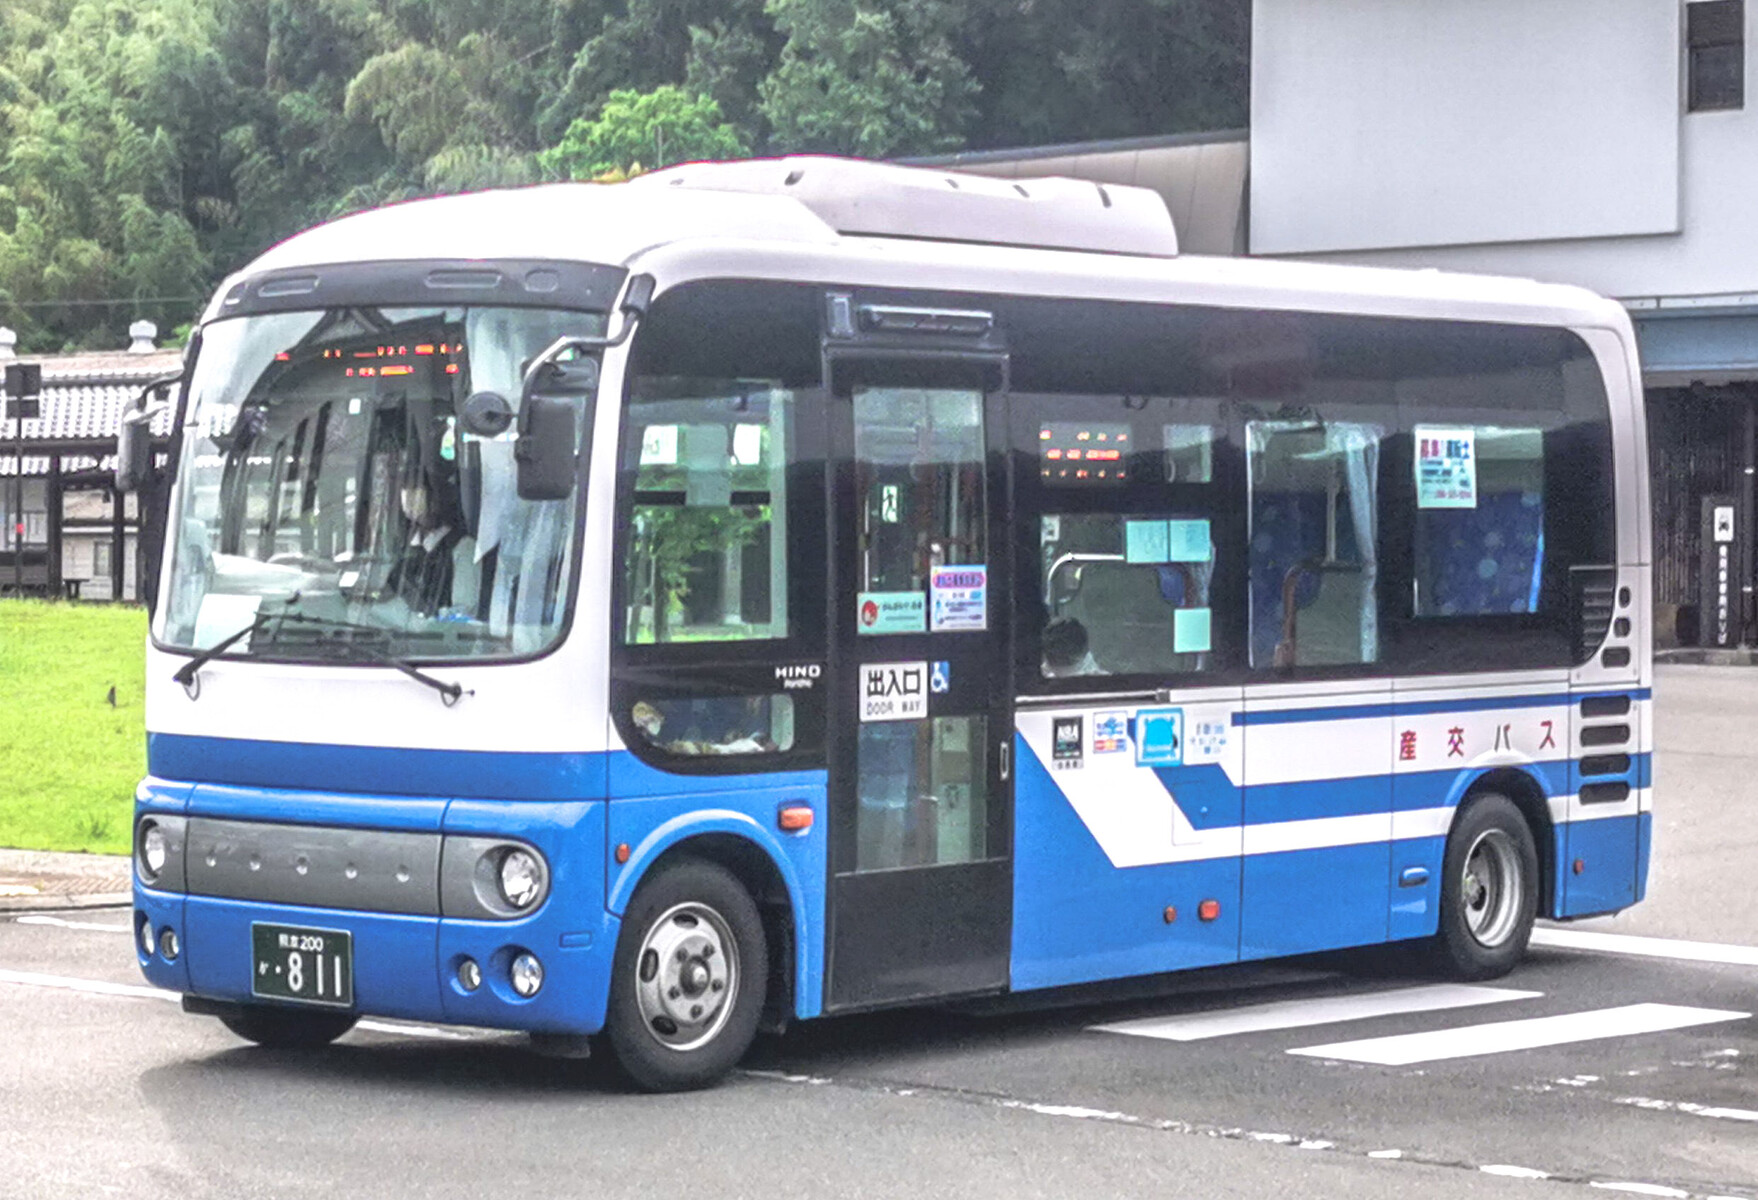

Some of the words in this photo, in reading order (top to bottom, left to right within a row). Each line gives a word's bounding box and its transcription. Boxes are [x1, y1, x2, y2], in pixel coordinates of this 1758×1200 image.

[775, 664, 821, 679] HINO
[866, 669, 921, 697] 出入口
[866, 701, 894, 716] DOOR
[902, 700, 921, 713] WAY
[1399, 719, 1556, 761] 産交バス
